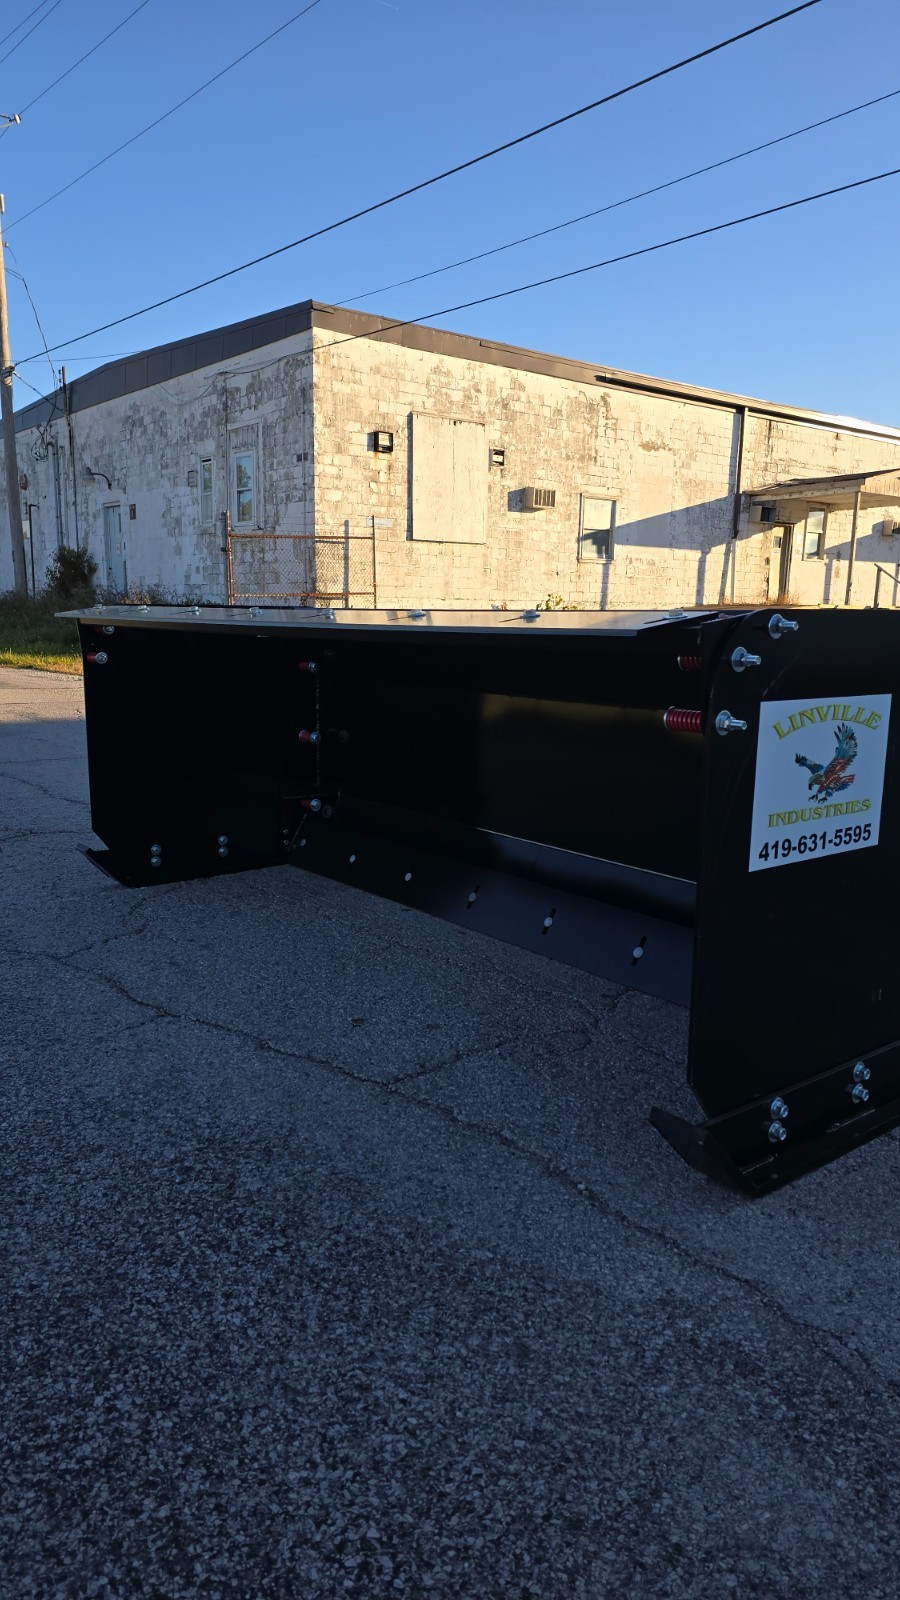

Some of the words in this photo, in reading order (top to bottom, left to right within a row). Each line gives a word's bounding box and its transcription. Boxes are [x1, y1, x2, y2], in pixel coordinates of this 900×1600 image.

[772, 704, 882, 740] LINVILLE
[767, 798, 871, 828] INDUSTRIES
[758, 823, 872, 861] 419-631-5595
